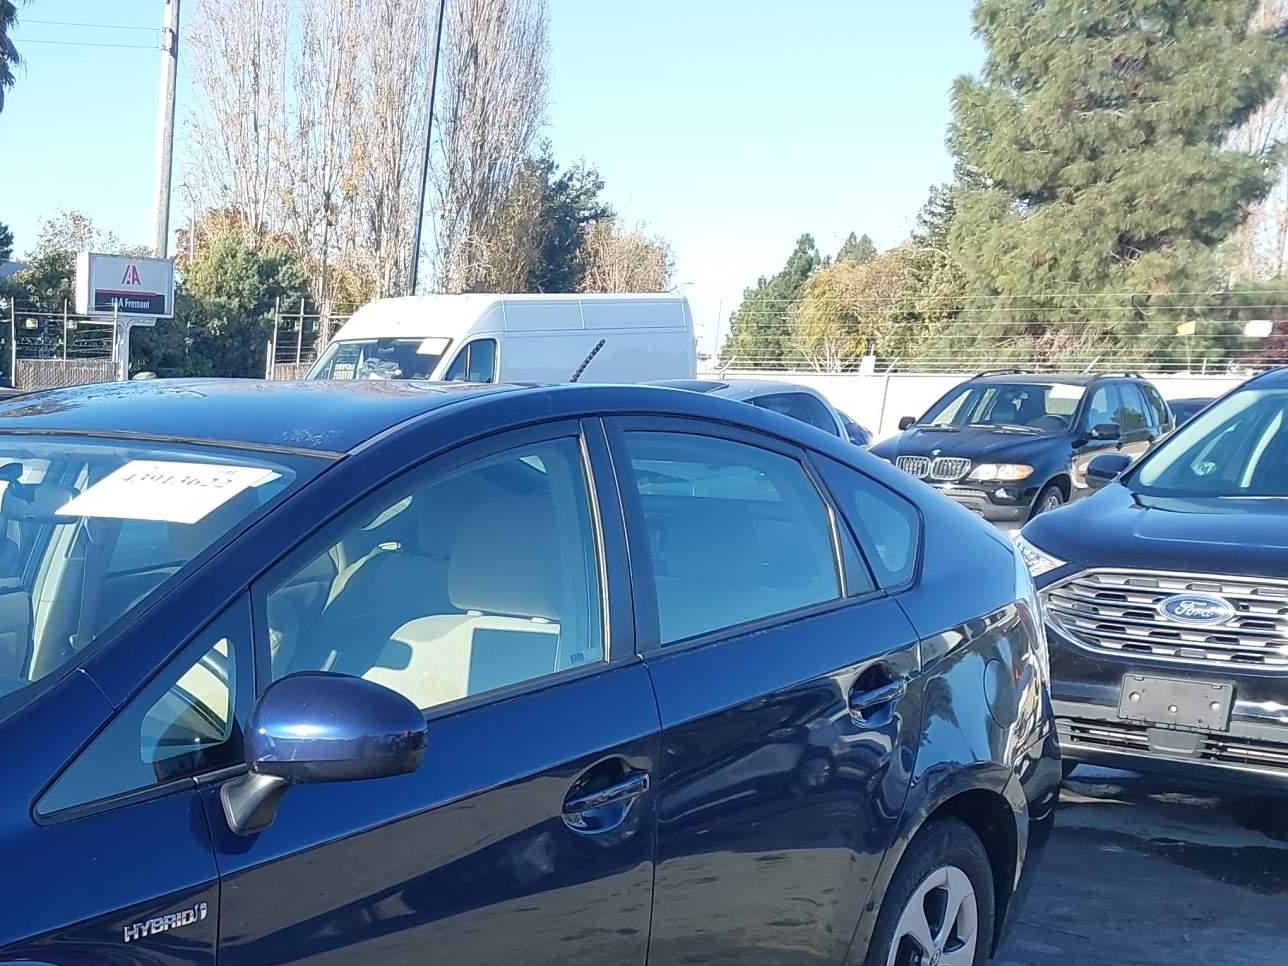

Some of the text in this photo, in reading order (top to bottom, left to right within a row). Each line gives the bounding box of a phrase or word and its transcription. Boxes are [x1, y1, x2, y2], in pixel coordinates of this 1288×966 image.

[124, 297, 150, 309] Fremont
[1174, 600, 1222, 618] Ford
[123, 908, 197, 943] HYBRID
